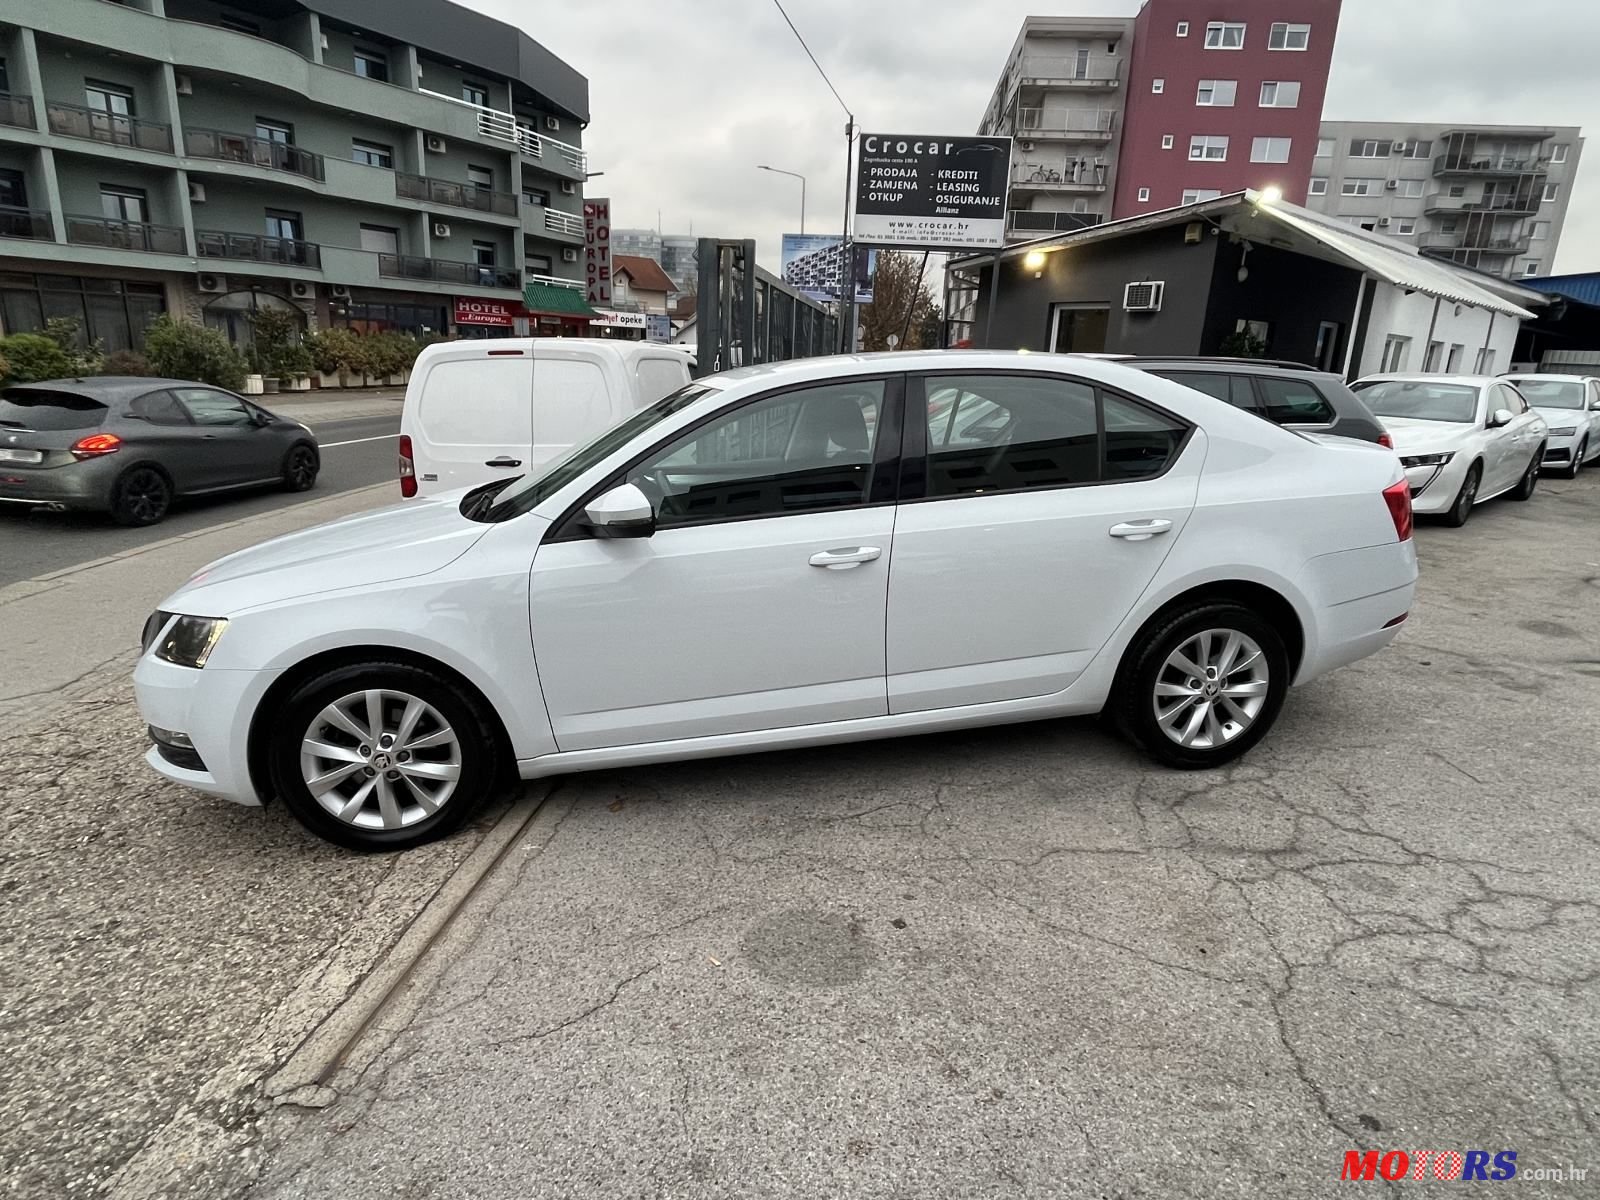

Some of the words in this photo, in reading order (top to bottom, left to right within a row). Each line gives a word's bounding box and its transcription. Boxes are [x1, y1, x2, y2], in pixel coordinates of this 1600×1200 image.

[865, 136, 954, 156] Crocar
[870, 167, 918, 178] PRODAJA
[937, 170, 978, 180] KREDITI
[869, 180, 918, 191] ZAMJENA
[936, 182, 980, 193] LEASING
[868, 192, 904, 202] OTKUP
[935, 195, 1001, 206] OSIGURANJE
[935, 206, 960, 214] Allianz
[888, 221, 969, 230] www.crocar.hr
[596, 205, 610, 302] HOTEL
[586, 219, 597, 302] EUROPA
[458, 302, 509, 315] HOTEL
[620, 314, 643, 325] opeke
